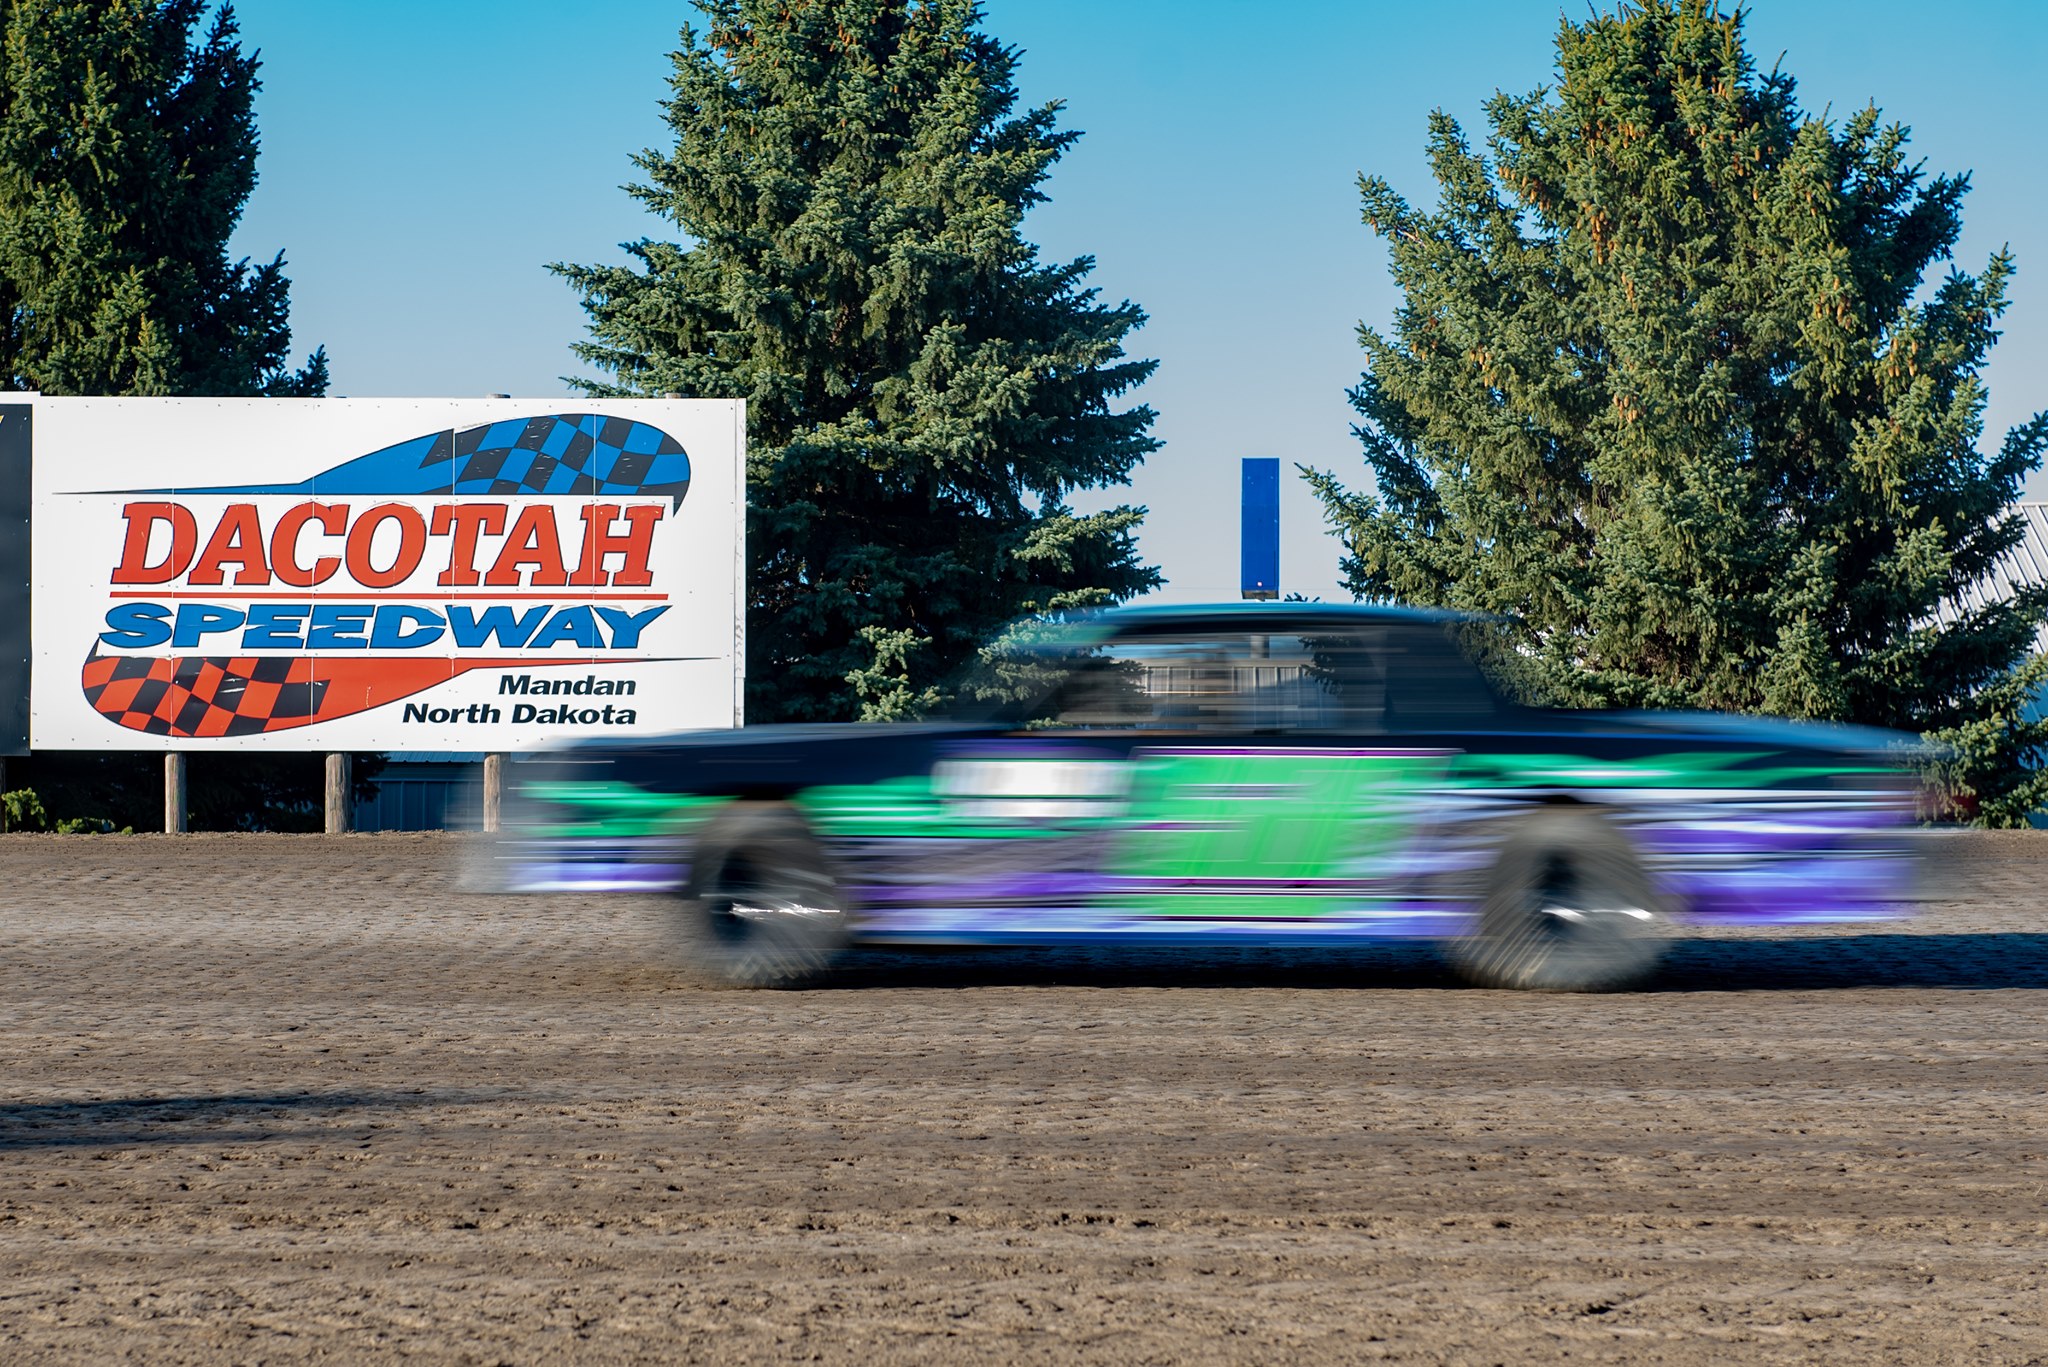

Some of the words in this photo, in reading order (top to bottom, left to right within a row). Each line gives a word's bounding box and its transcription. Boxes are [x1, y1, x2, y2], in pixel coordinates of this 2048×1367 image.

[111, 502, 664, 588] DACOTAH
[99, 603, 672, 649] SPEEDWAY
[499, 675, 637, 696] Mandan
[402, 703, 500, 724] North
[511, 703, 637, 725] Dakota
